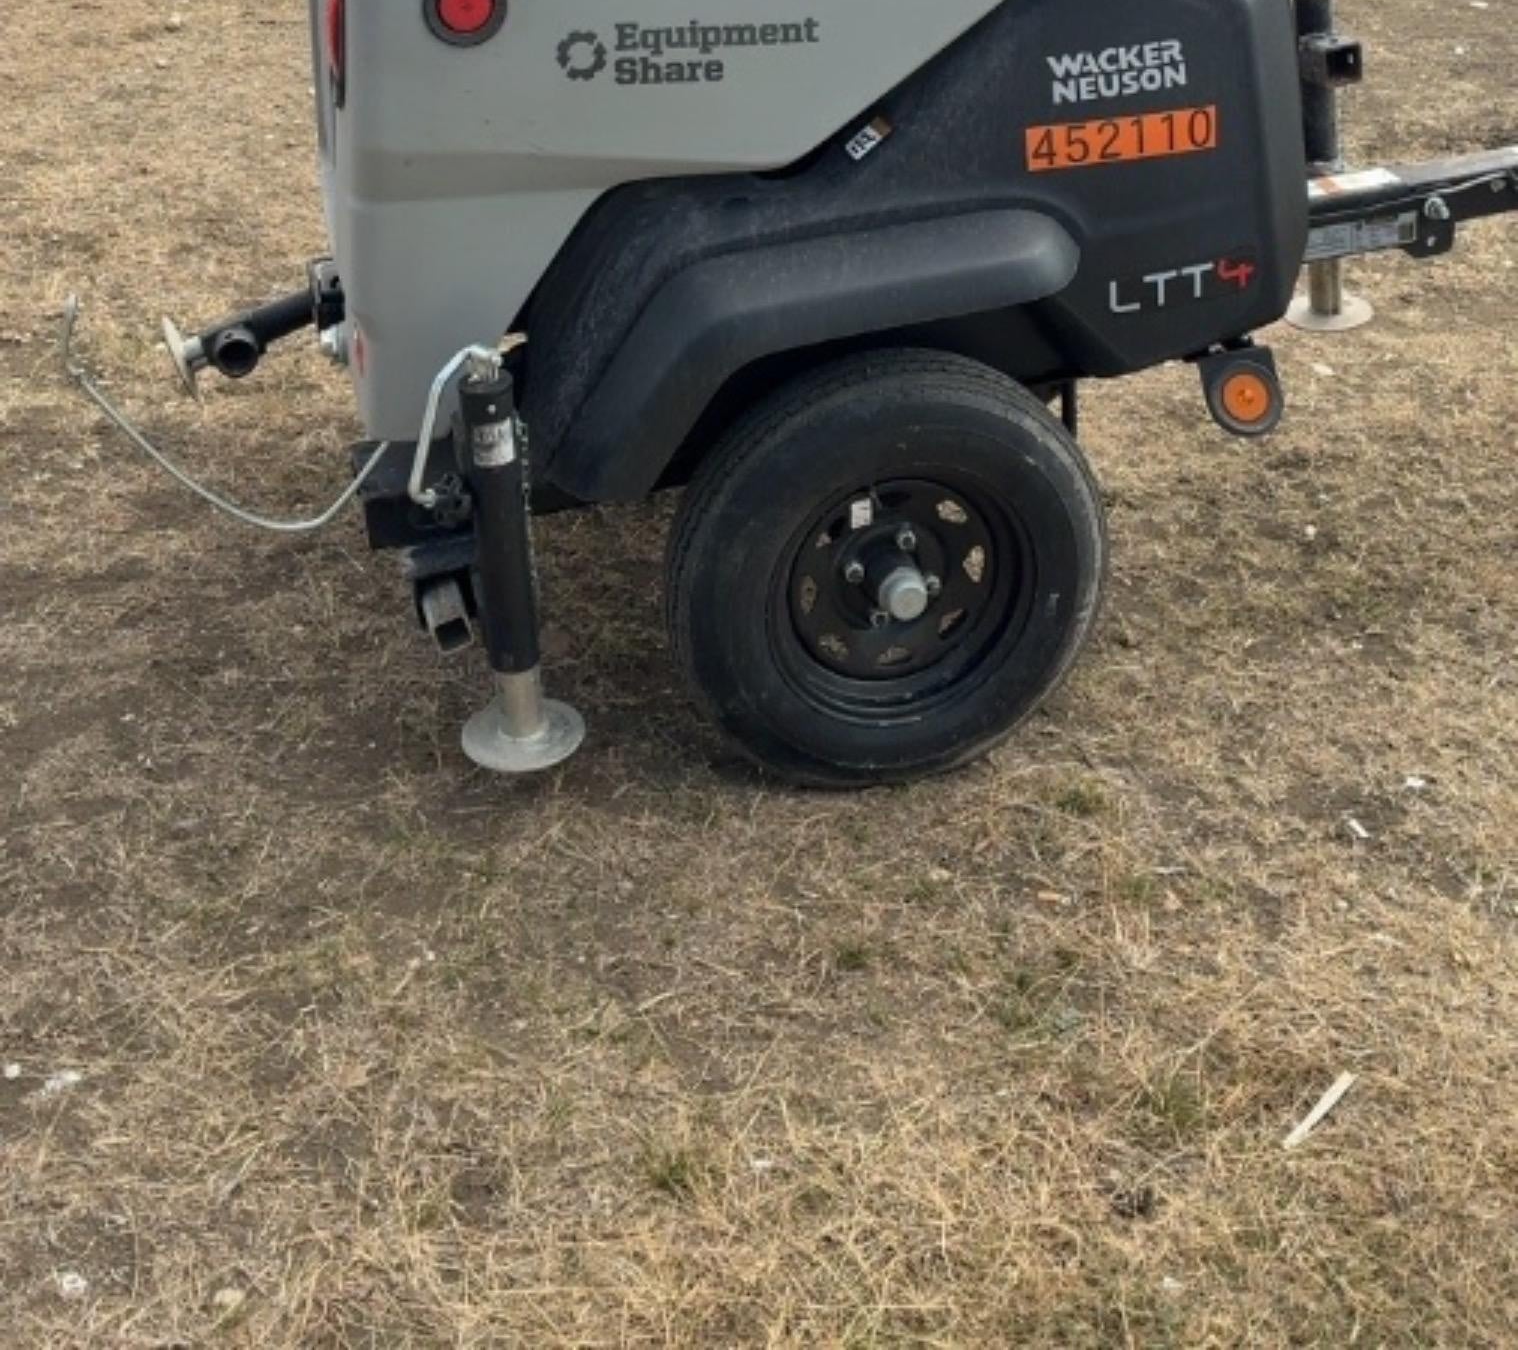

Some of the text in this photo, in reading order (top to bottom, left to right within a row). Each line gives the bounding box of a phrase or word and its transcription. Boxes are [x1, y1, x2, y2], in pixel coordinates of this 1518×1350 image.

[614, 17, 820, 55] Equipment
[614, 56, 724, 85] Share
[1047, 38, 1184, 80] WACKER
[1052, 62, 1188, 104] NEUSON
[1031, 110, 1211, 166] 452110
